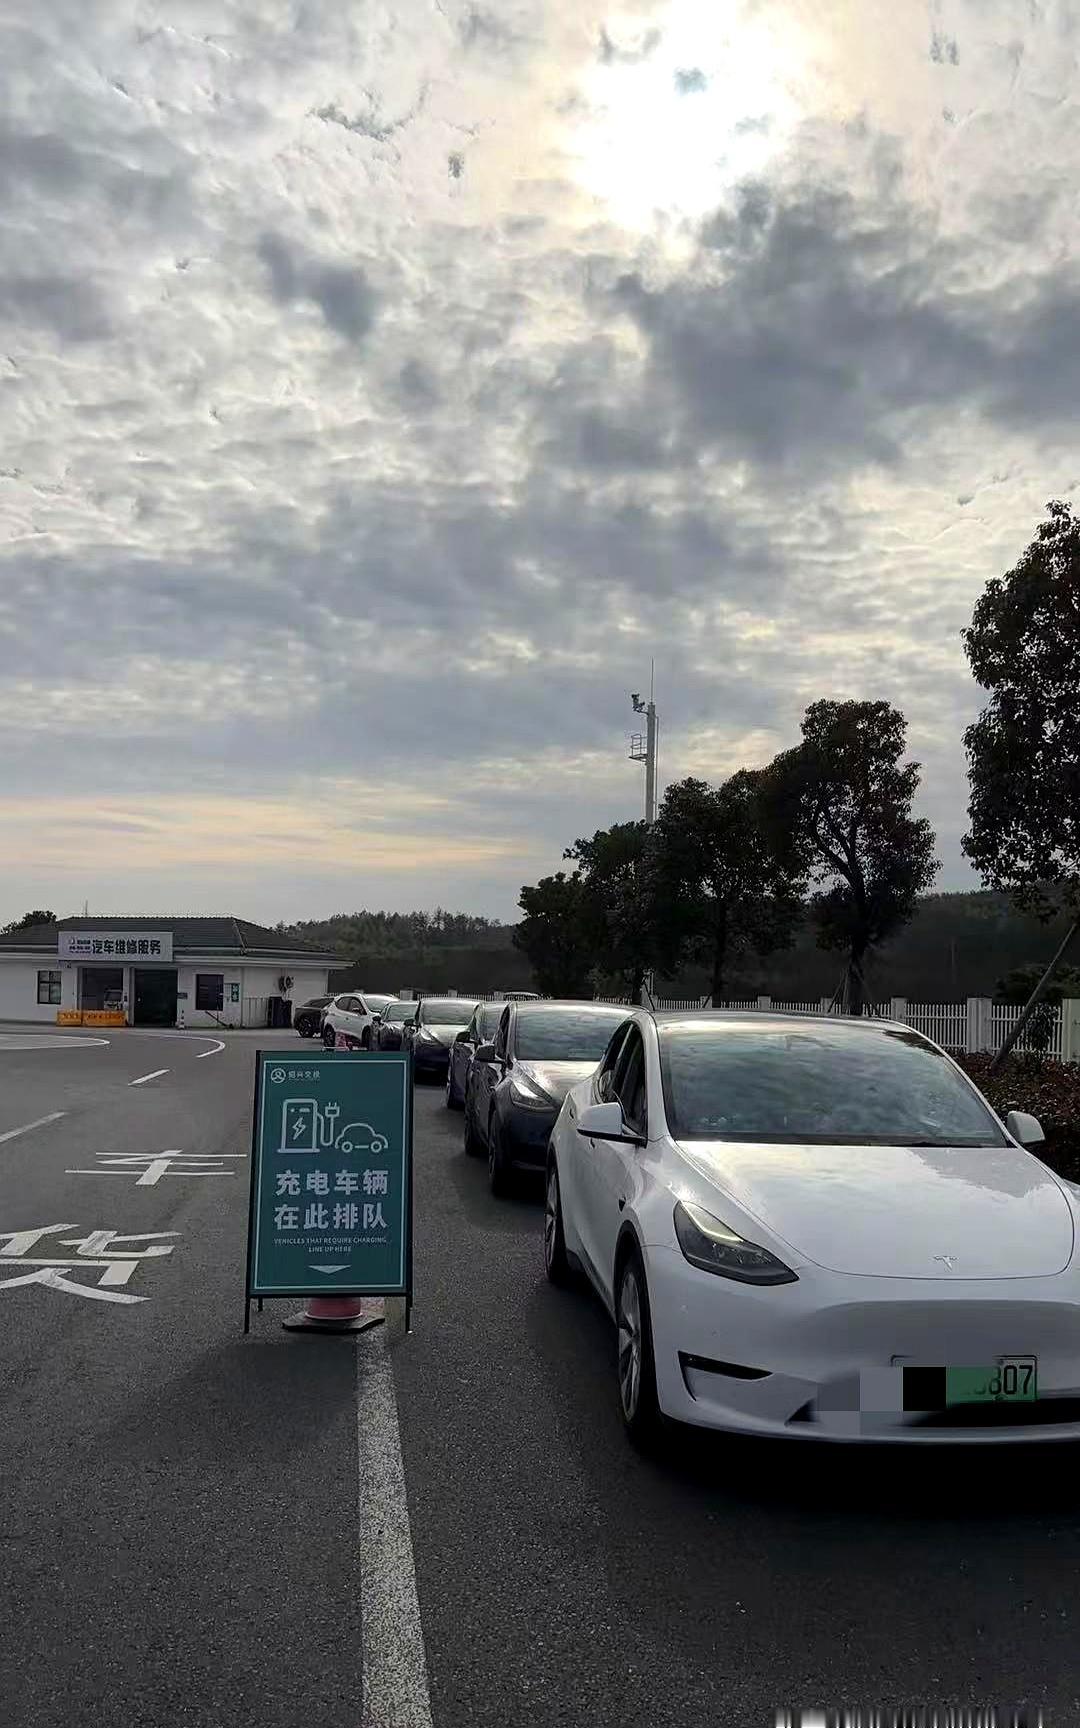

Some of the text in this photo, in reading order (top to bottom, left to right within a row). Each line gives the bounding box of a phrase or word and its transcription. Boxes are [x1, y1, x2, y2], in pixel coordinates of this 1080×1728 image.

[92, 939, 161, 955] 汽车维修服务
[64, 1149, 248, 1186] 车
[276, 1169, 388, 1195] 充电车辆
[274, 1203, 387, 1229] 在此排队
